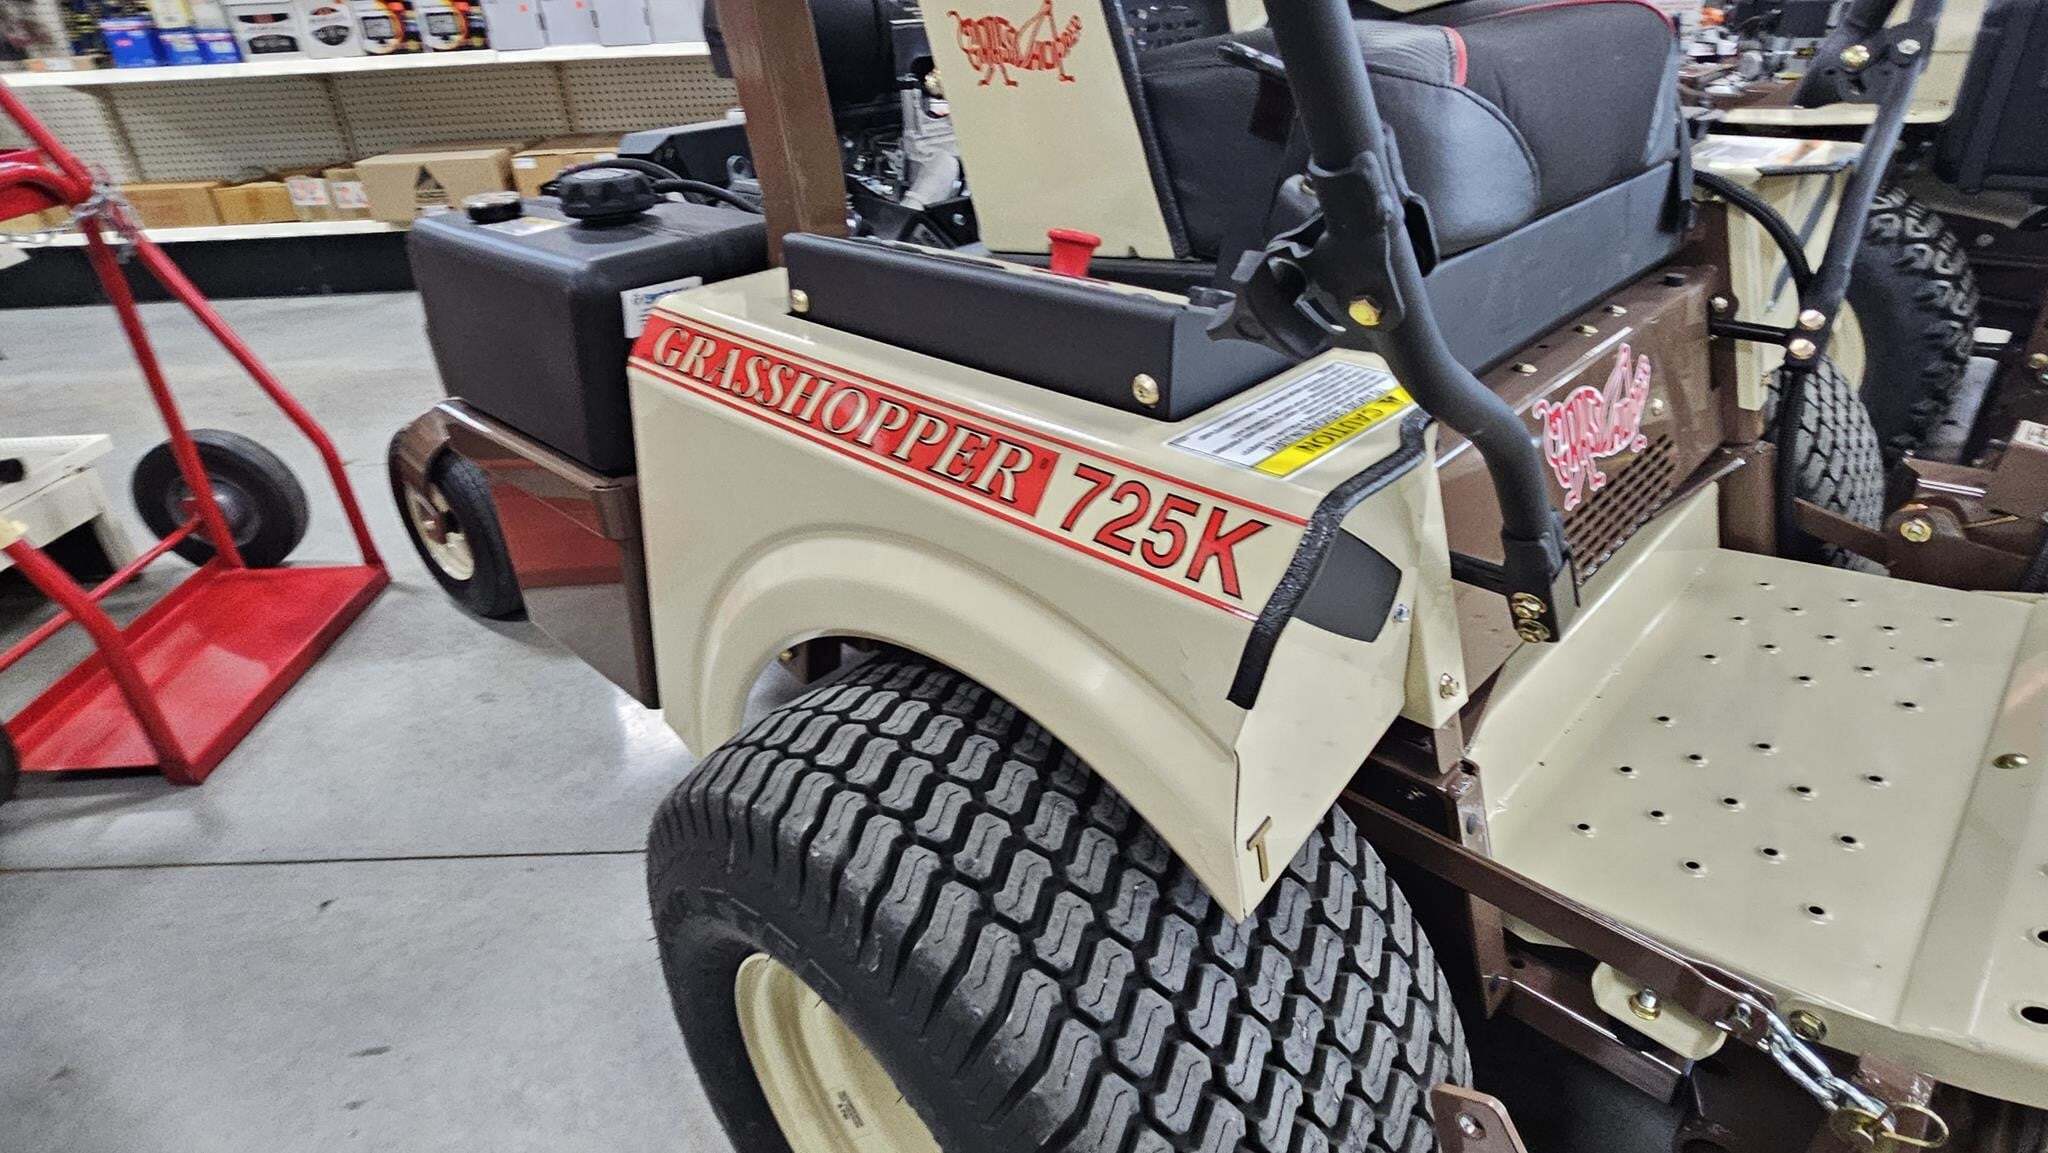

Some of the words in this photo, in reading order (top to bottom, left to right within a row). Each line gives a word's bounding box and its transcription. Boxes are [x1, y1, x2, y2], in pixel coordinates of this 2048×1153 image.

[652, 326, 1034, 503] GRASSHOPPER
[1059, 463, 1271, 600] 725K
[1297, 408, 1383, 453] CAUTION
